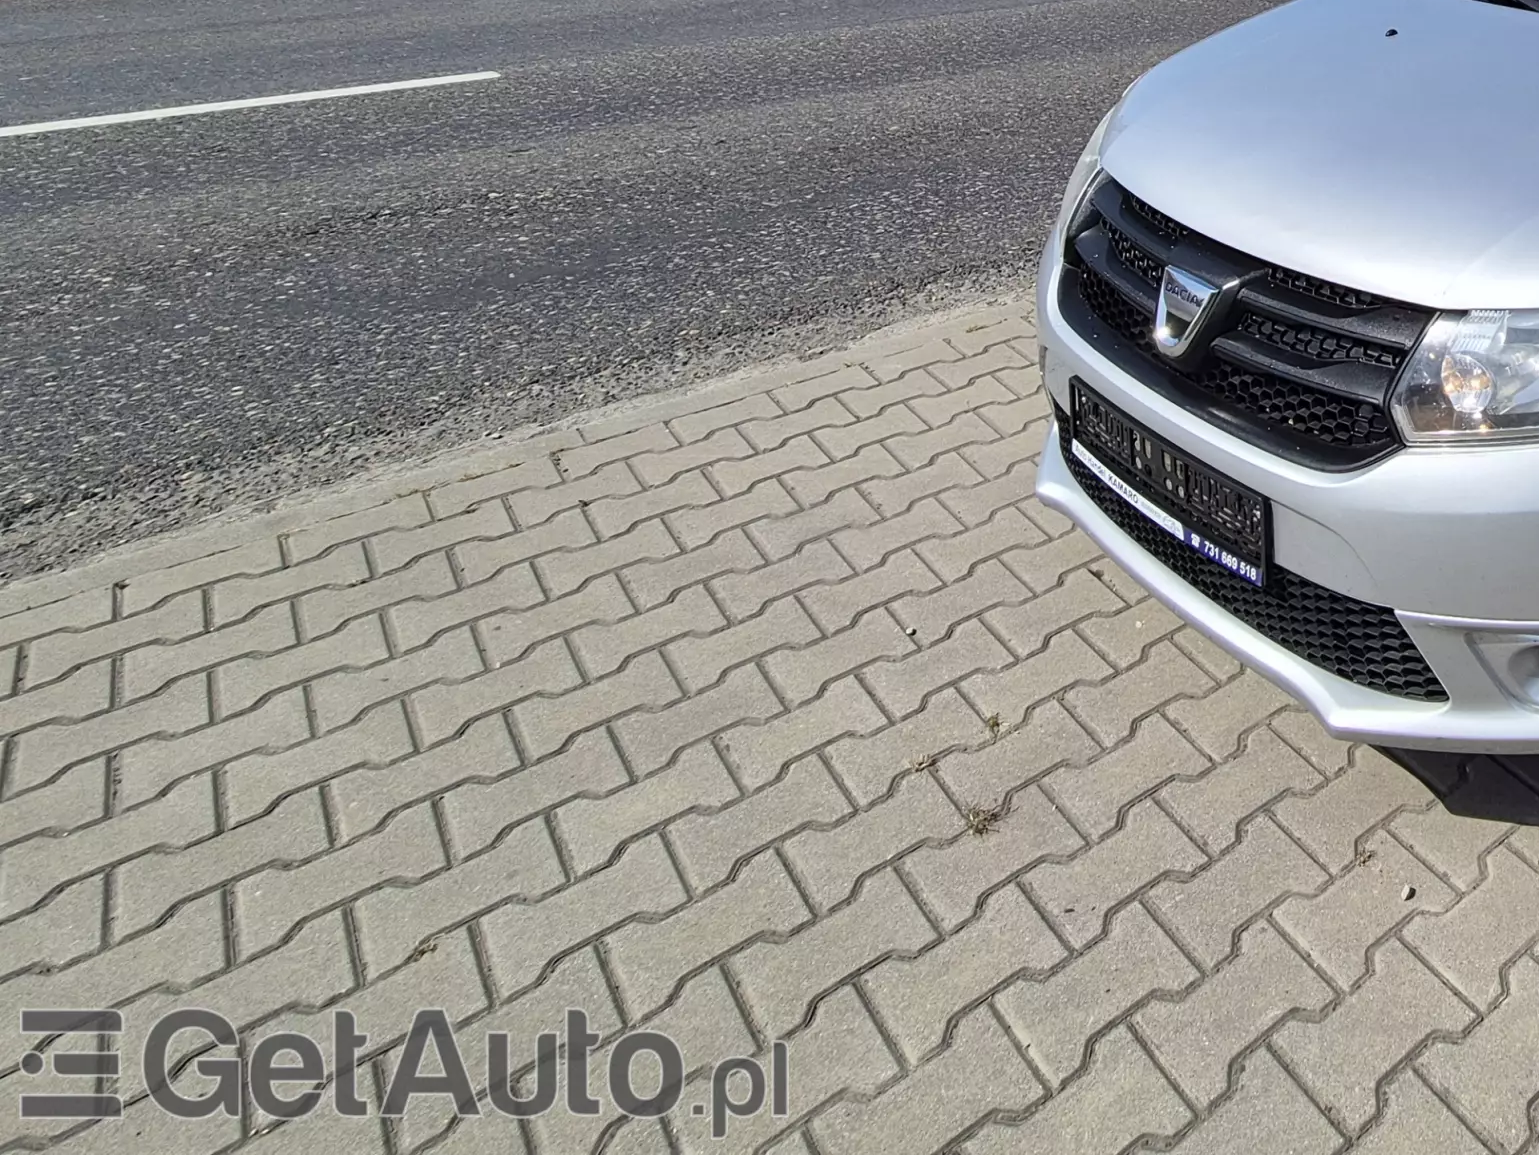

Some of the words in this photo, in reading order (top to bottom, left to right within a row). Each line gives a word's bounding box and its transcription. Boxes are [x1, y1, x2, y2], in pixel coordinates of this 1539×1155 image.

[1165, 281, 1199, 306] DACIA
[1107, 474, 1139, 504] KAMARO
[1204, 540, 1219, 560] 731
[1221, 551, 1238, 570] 669
[1240, 561, 1257, 581] 518
